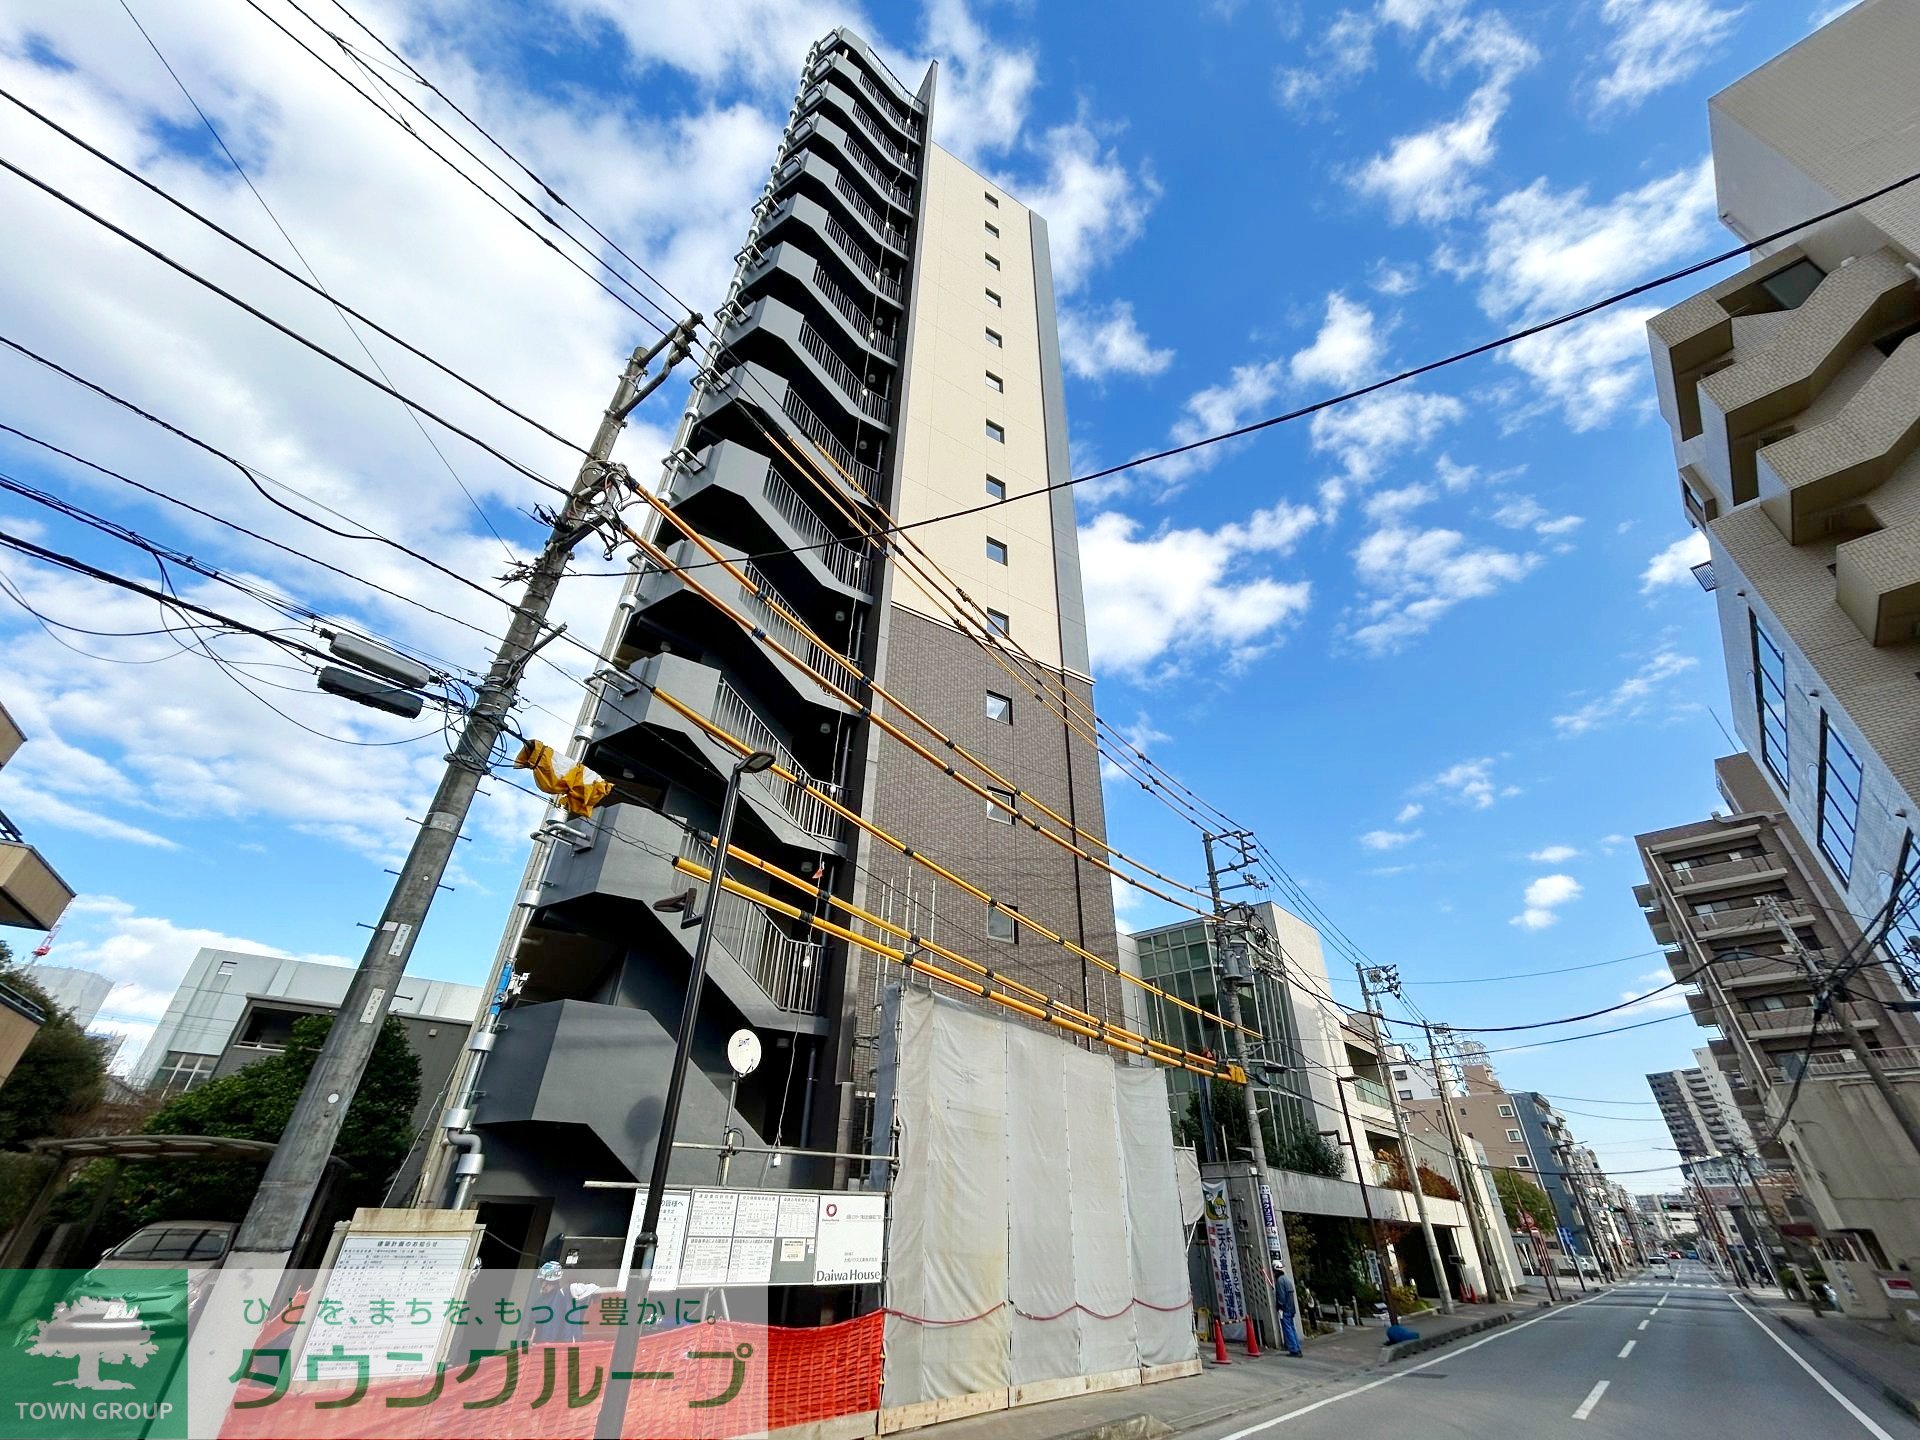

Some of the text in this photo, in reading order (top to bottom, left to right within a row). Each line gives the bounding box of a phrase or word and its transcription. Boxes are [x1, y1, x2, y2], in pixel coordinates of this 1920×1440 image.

[377, 1240, 438, 1248] 建築計画のお知らせ
[816, 1269, 880, 1282] Daiwa House
